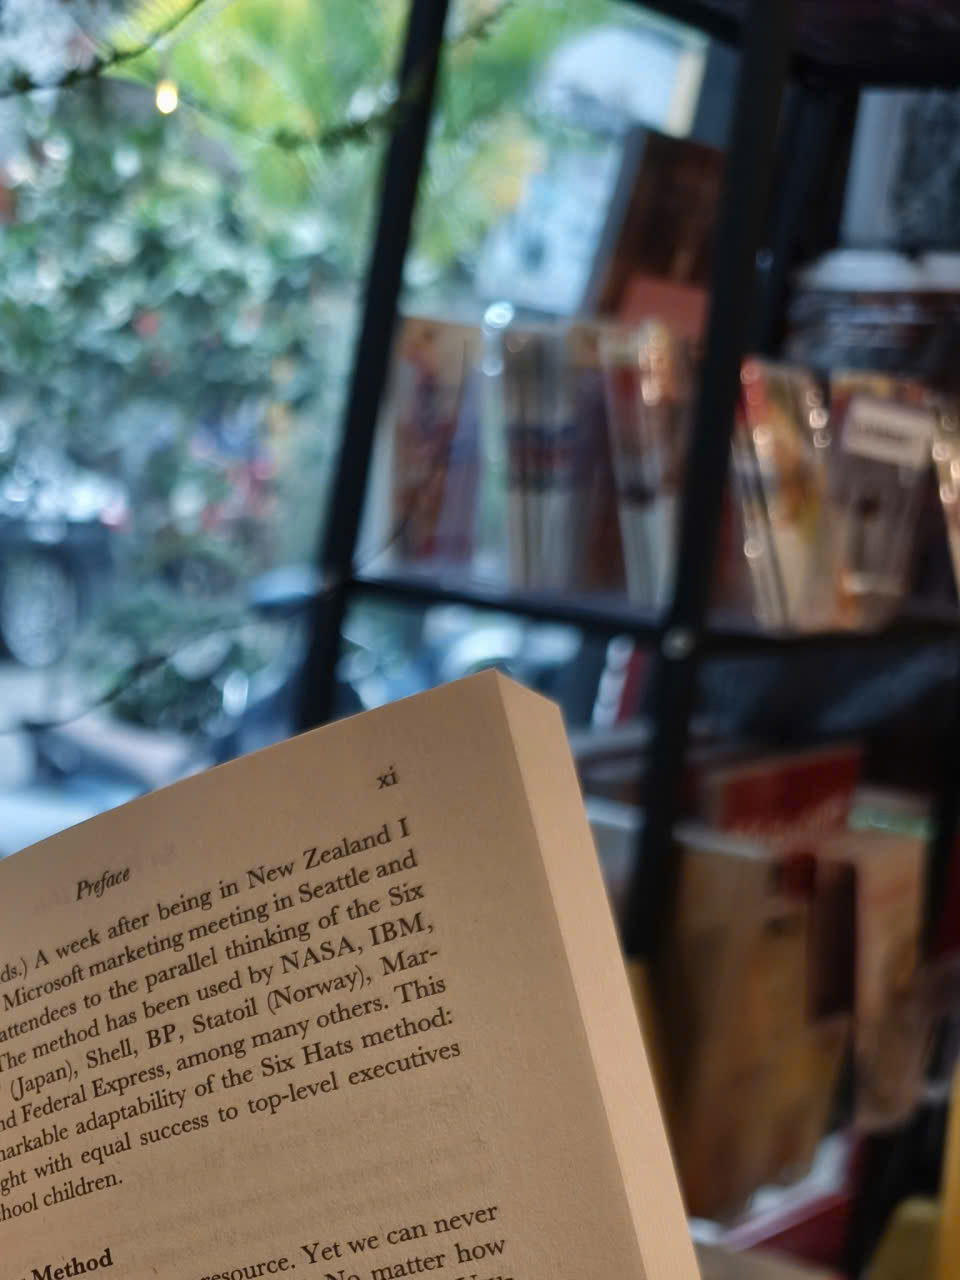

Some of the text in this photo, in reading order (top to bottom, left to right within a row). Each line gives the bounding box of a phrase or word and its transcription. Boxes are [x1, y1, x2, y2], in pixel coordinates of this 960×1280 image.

[376, 766, 398, 789] xi
[35, 950, 49, 969] A
[56, 928, 101, 959] week
[108, 913, 149, 939] after
[156, 891, 213, 921] being
[219, 880, 239, 899] in
[246, 862, 295, 889] New
[303, 823, 391, 870] Zealand
[398, 816, 410, 838] I
[75, 866, 130, 901] Preface
[10, 1060, 78, 1102] (Japan),
[86, 1038, 138, 1069] Shell,
[145, 1023, 184, 1049] BP,
[192, 997, 259, 1034] Statoil
[268, 965, 371, 1015] (Norway),
[379, 950, 438, 976] Mar-
[300, 1242, 343, 1264] Yet
[346, 1235, 379, 1254] we
[386, 1224, 428, 1245] can
[434, 1206, 498, 1234] never
